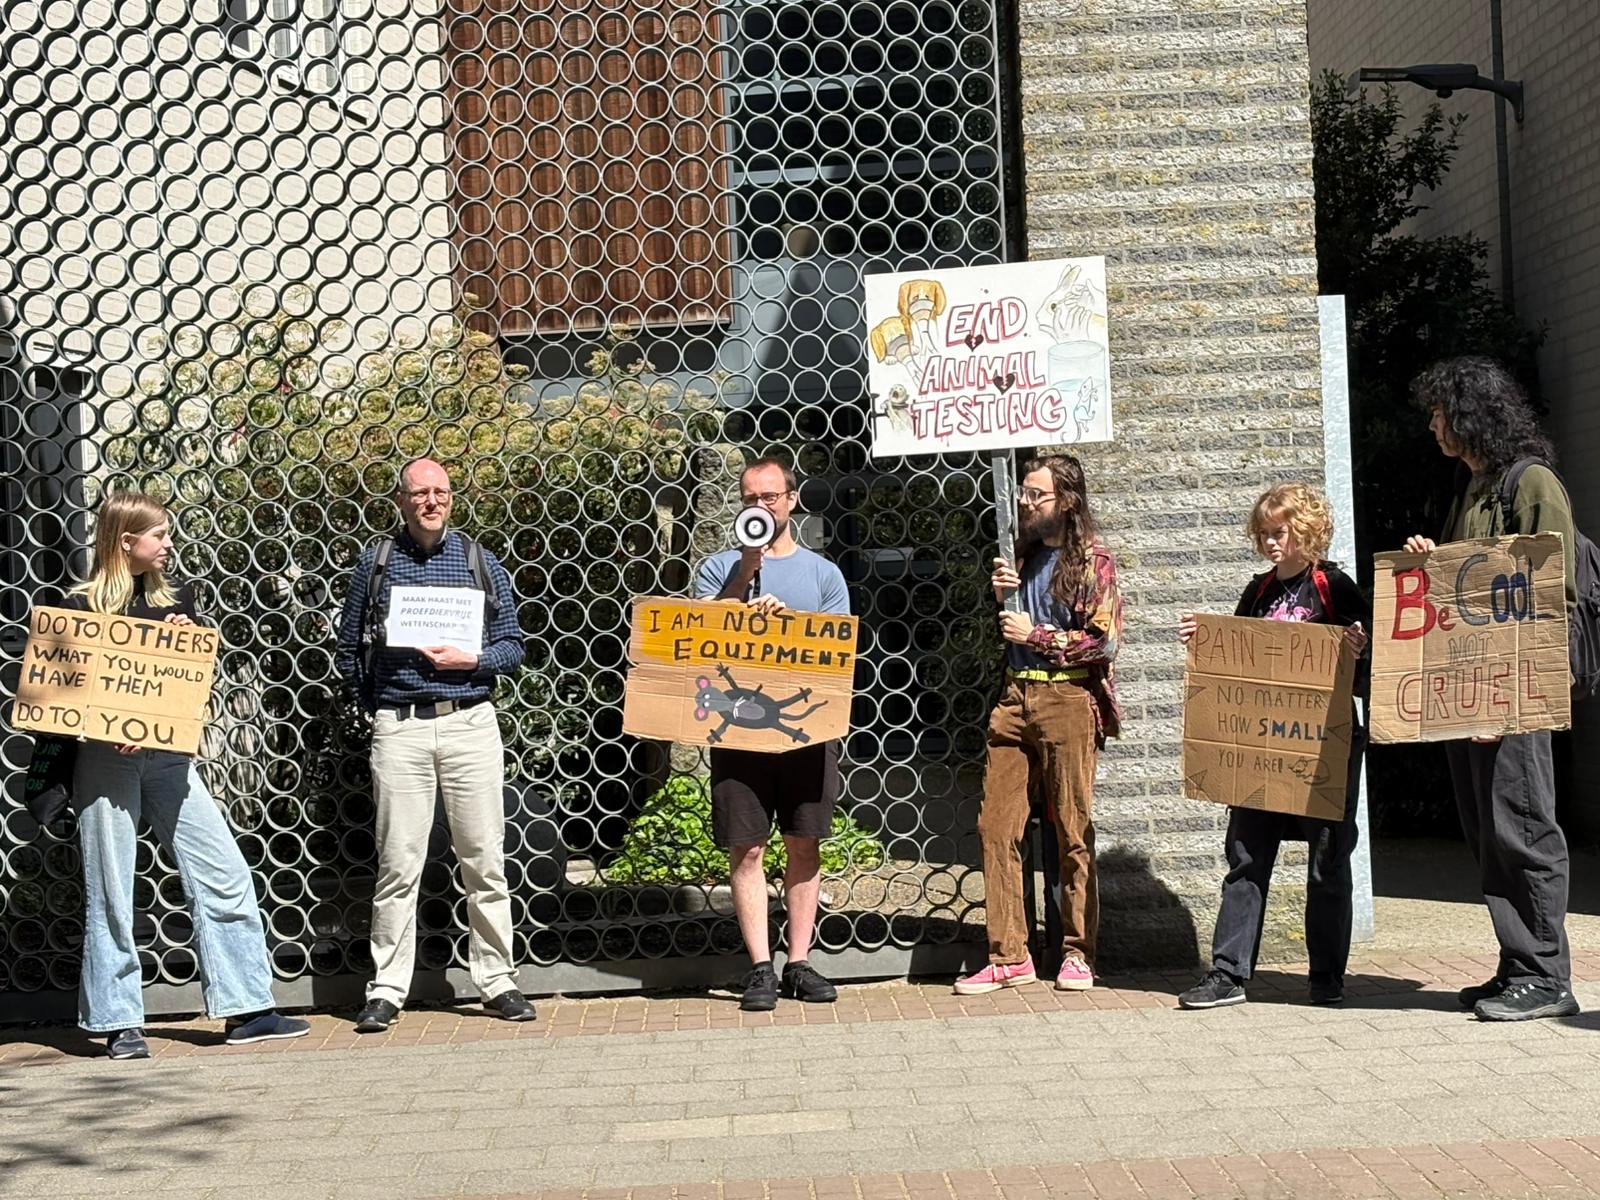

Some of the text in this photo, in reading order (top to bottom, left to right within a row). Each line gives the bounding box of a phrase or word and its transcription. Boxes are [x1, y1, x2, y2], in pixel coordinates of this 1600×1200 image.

[946, 296, 1028, 347] END
[919, 350, 1047, 396] ANIMAL
[910, 388, 1067, 439] TESTING
[1391, 566, 1457, 641] Be
[37, 611, 215, 654] DO TO OTHERS
[648, 609, 852, 641] I AM NOT LAB
[32, 644, 204, 683] WHAT YOU WOULD
[673, 637, 851, 668] EQUIPMENT
[1193, 623, 1255, 668] PAIN
[1289, 632, 1344, 676] PAIN
[1448, 630, 1494, 667] NOT
[28, 663, 163, 697] HAVE THEM
[1216, 684, 1325, 710] NO MATTER
[1396, 659, 1550, 723] CRUEL
[17, 702, 175, 745] DO TO YOU
[1217, 711, 1329, 742] HOW SMALL
[1218, 750, 1245, 769] YOU
